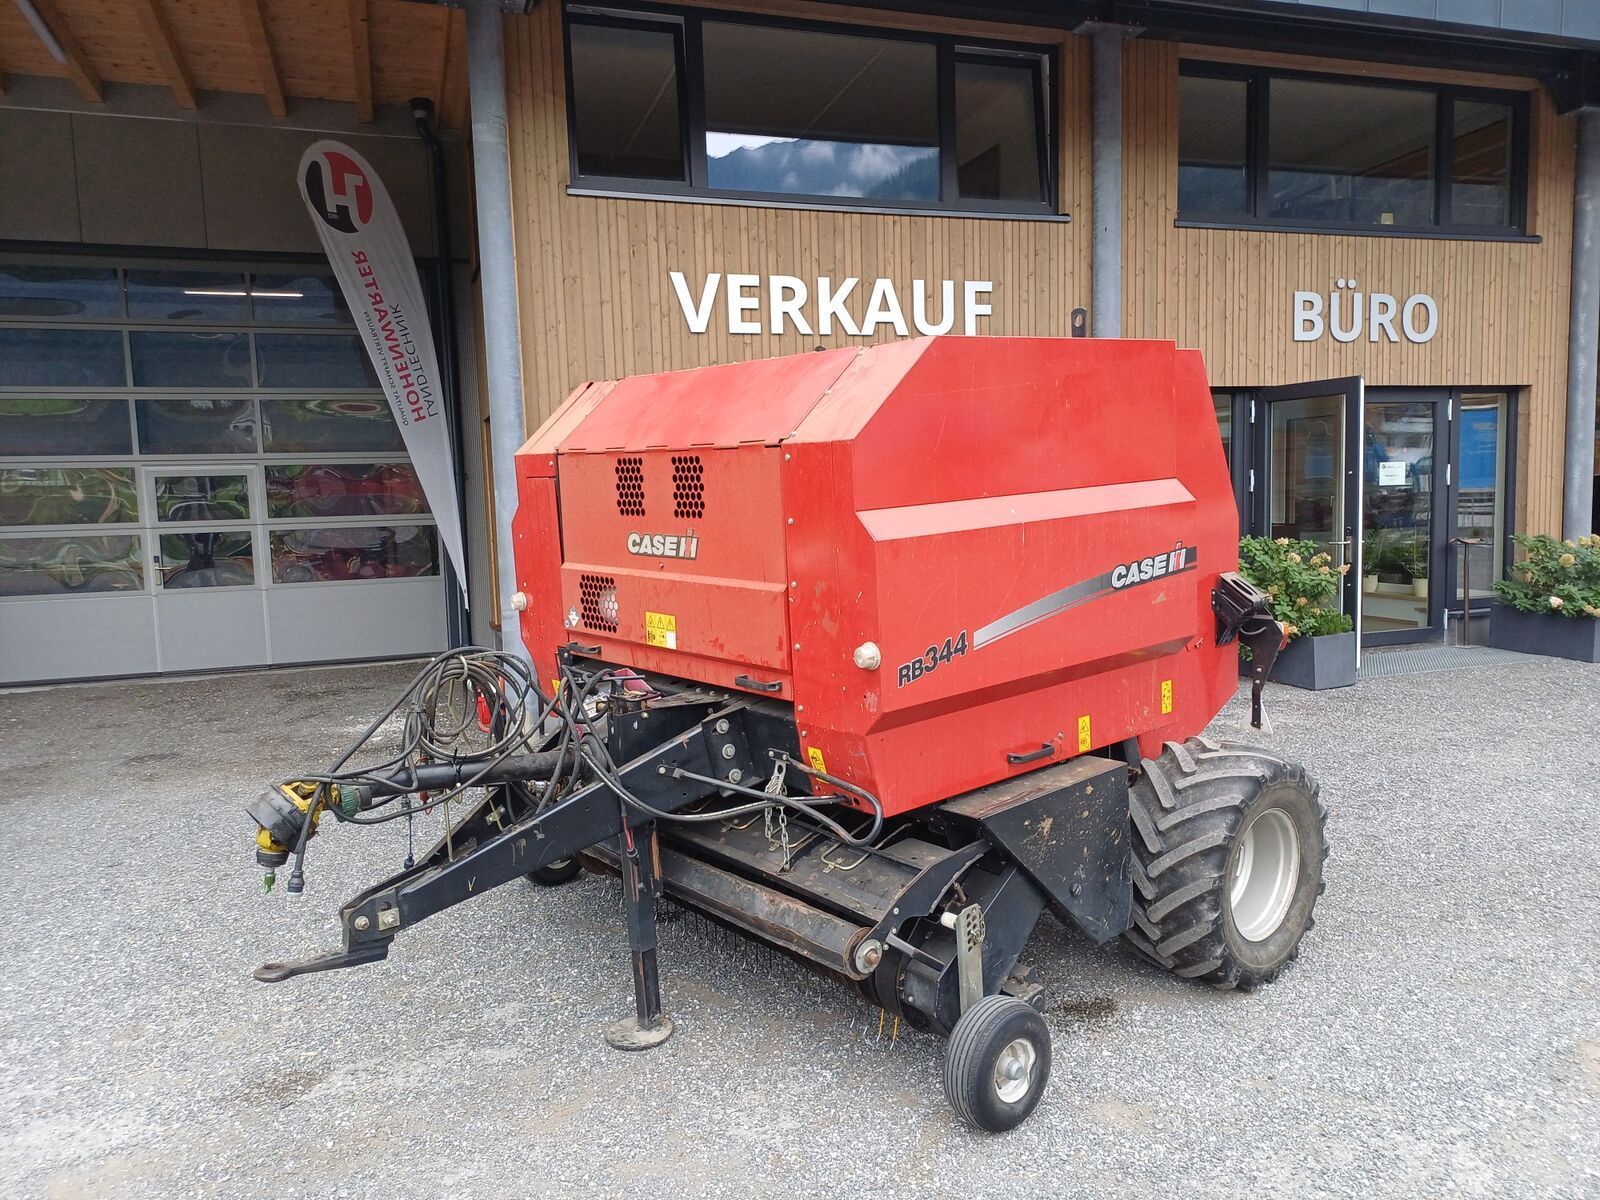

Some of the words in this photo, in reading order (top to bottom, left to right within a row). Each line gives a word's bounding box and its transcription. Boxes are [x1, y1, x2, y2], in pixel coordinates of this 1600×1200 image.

[669, 271, 993, 336] VERKAUF
[1293, 278, 1439, 344] BÜRO
[628, 532, 677, 557] CASE
[1111, 553, 1167, 589] CASE
[898, 630, 968, 688] RB344
